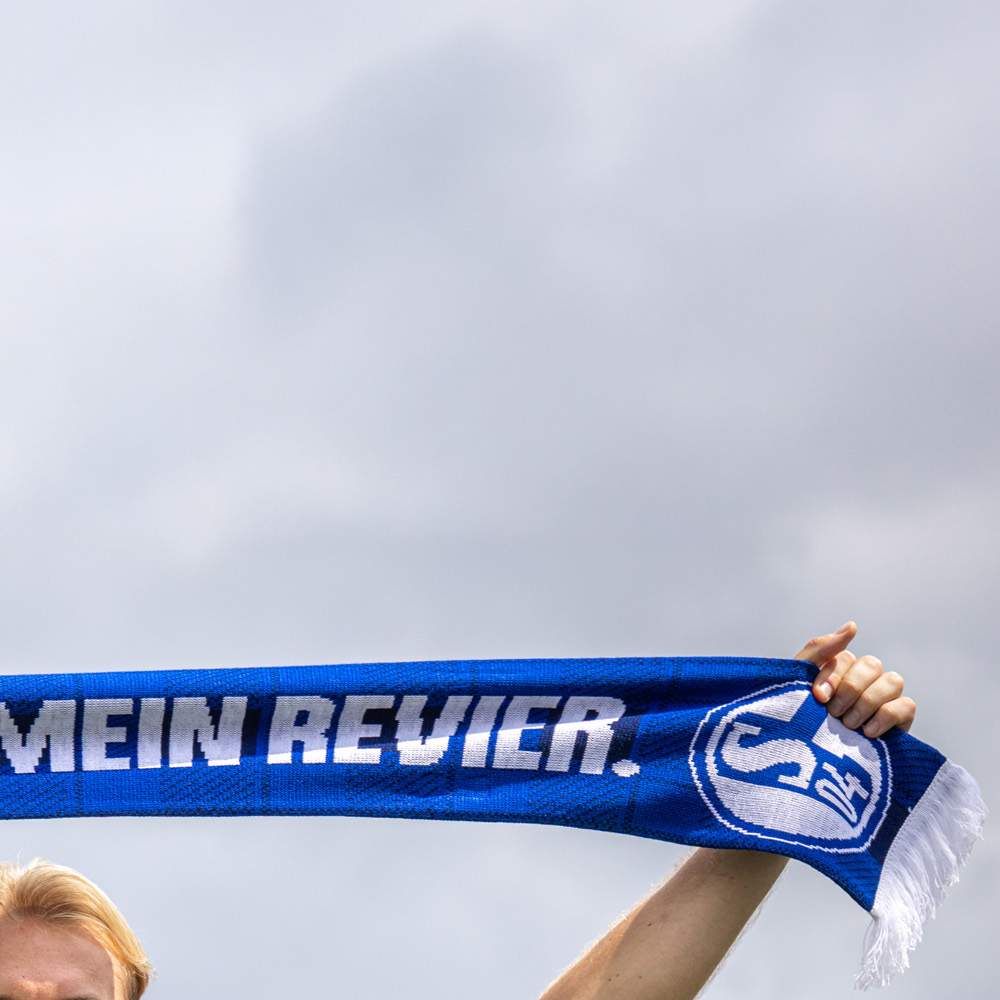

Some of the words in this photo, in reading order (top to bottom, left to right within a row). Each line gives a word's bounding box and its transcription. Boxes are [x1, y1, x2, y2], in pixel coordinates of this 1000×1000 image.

[266, 695, 641, 778] REVIER.
[721, 721, 817, 790] S
[814, 761, 870, 824] 04
